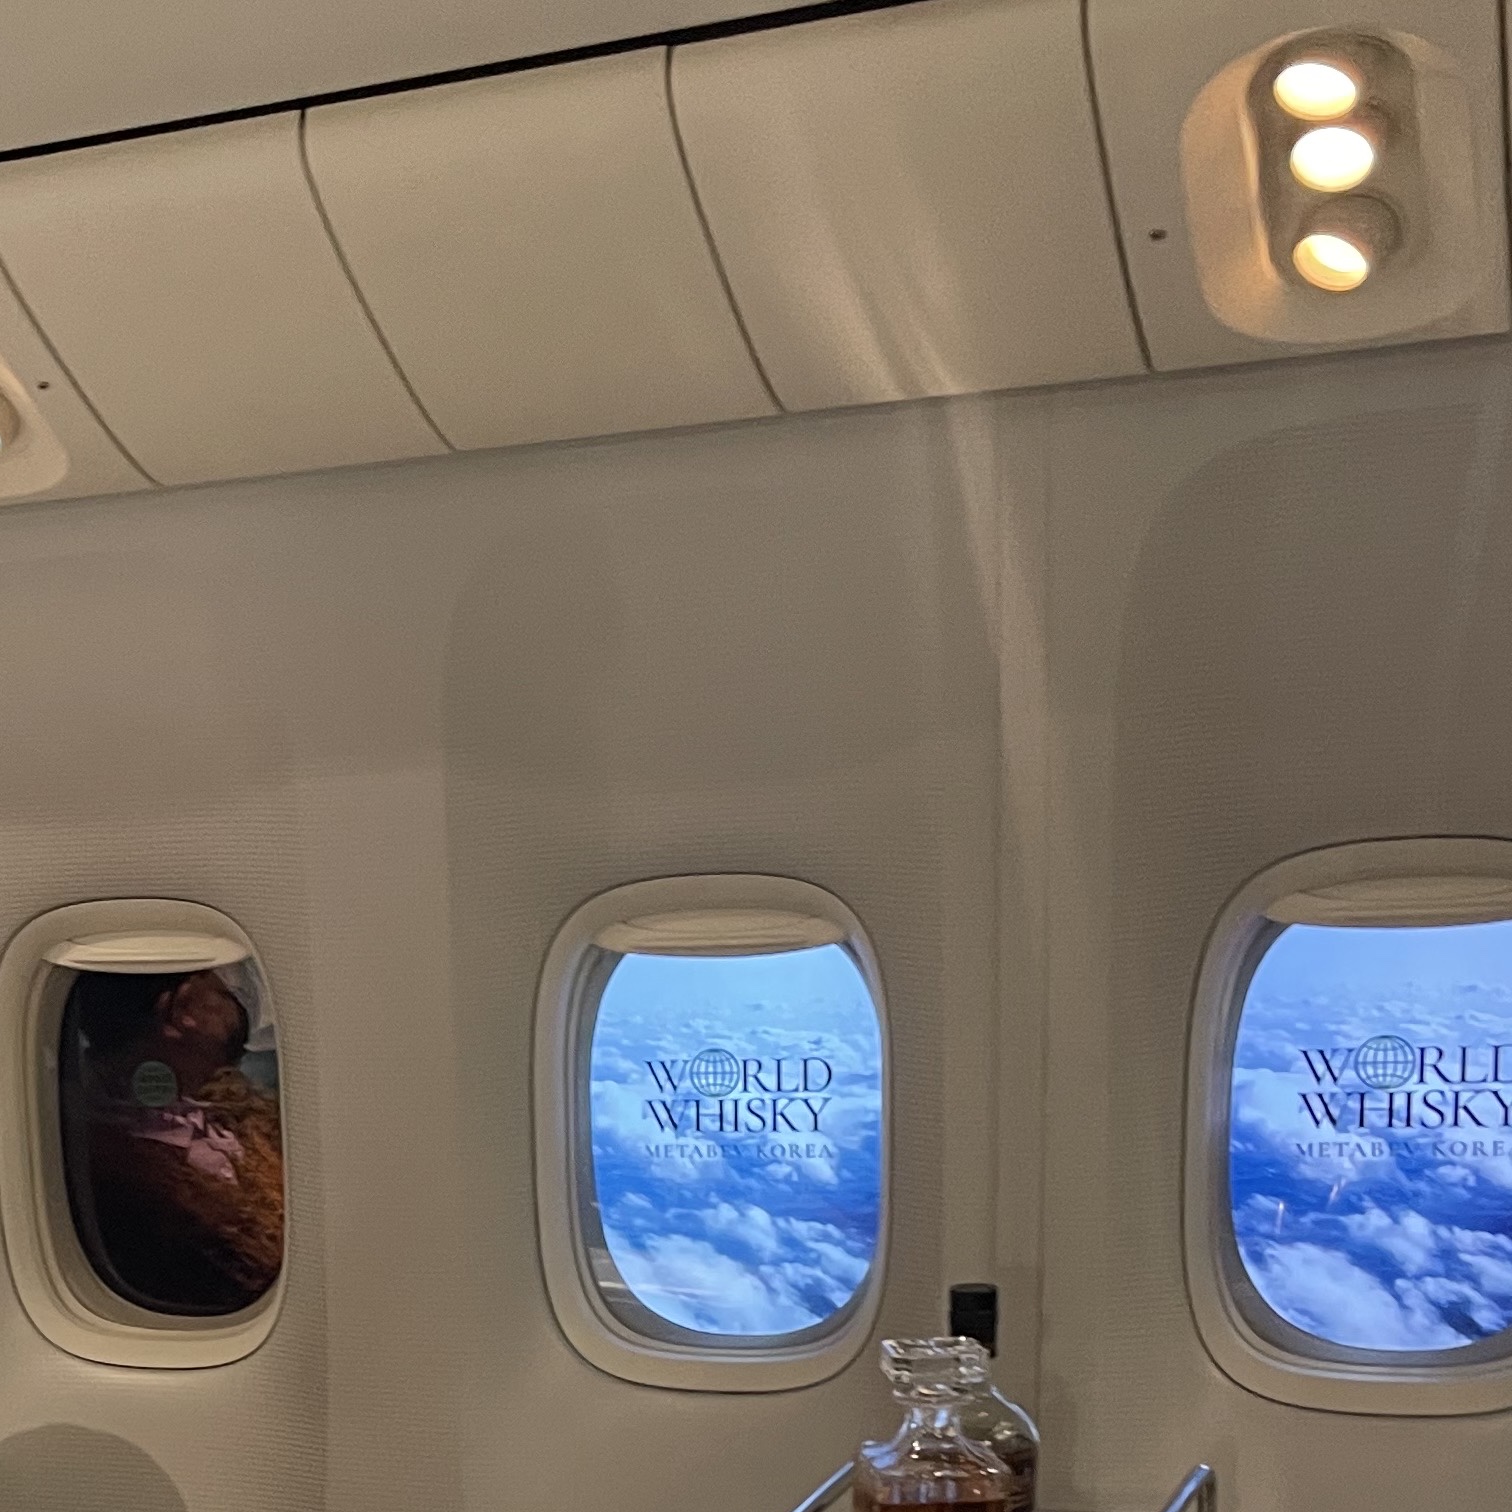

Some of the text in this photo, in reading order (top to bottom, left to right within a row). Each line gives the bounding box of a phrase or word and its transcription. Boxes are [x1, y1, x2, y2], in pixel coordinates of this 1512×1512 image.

[644, 1048, 833, 1097] WORLD
[643, 1097, 833, 1134] WHISKY
[755, 1143, 835, 1160] KOREA
